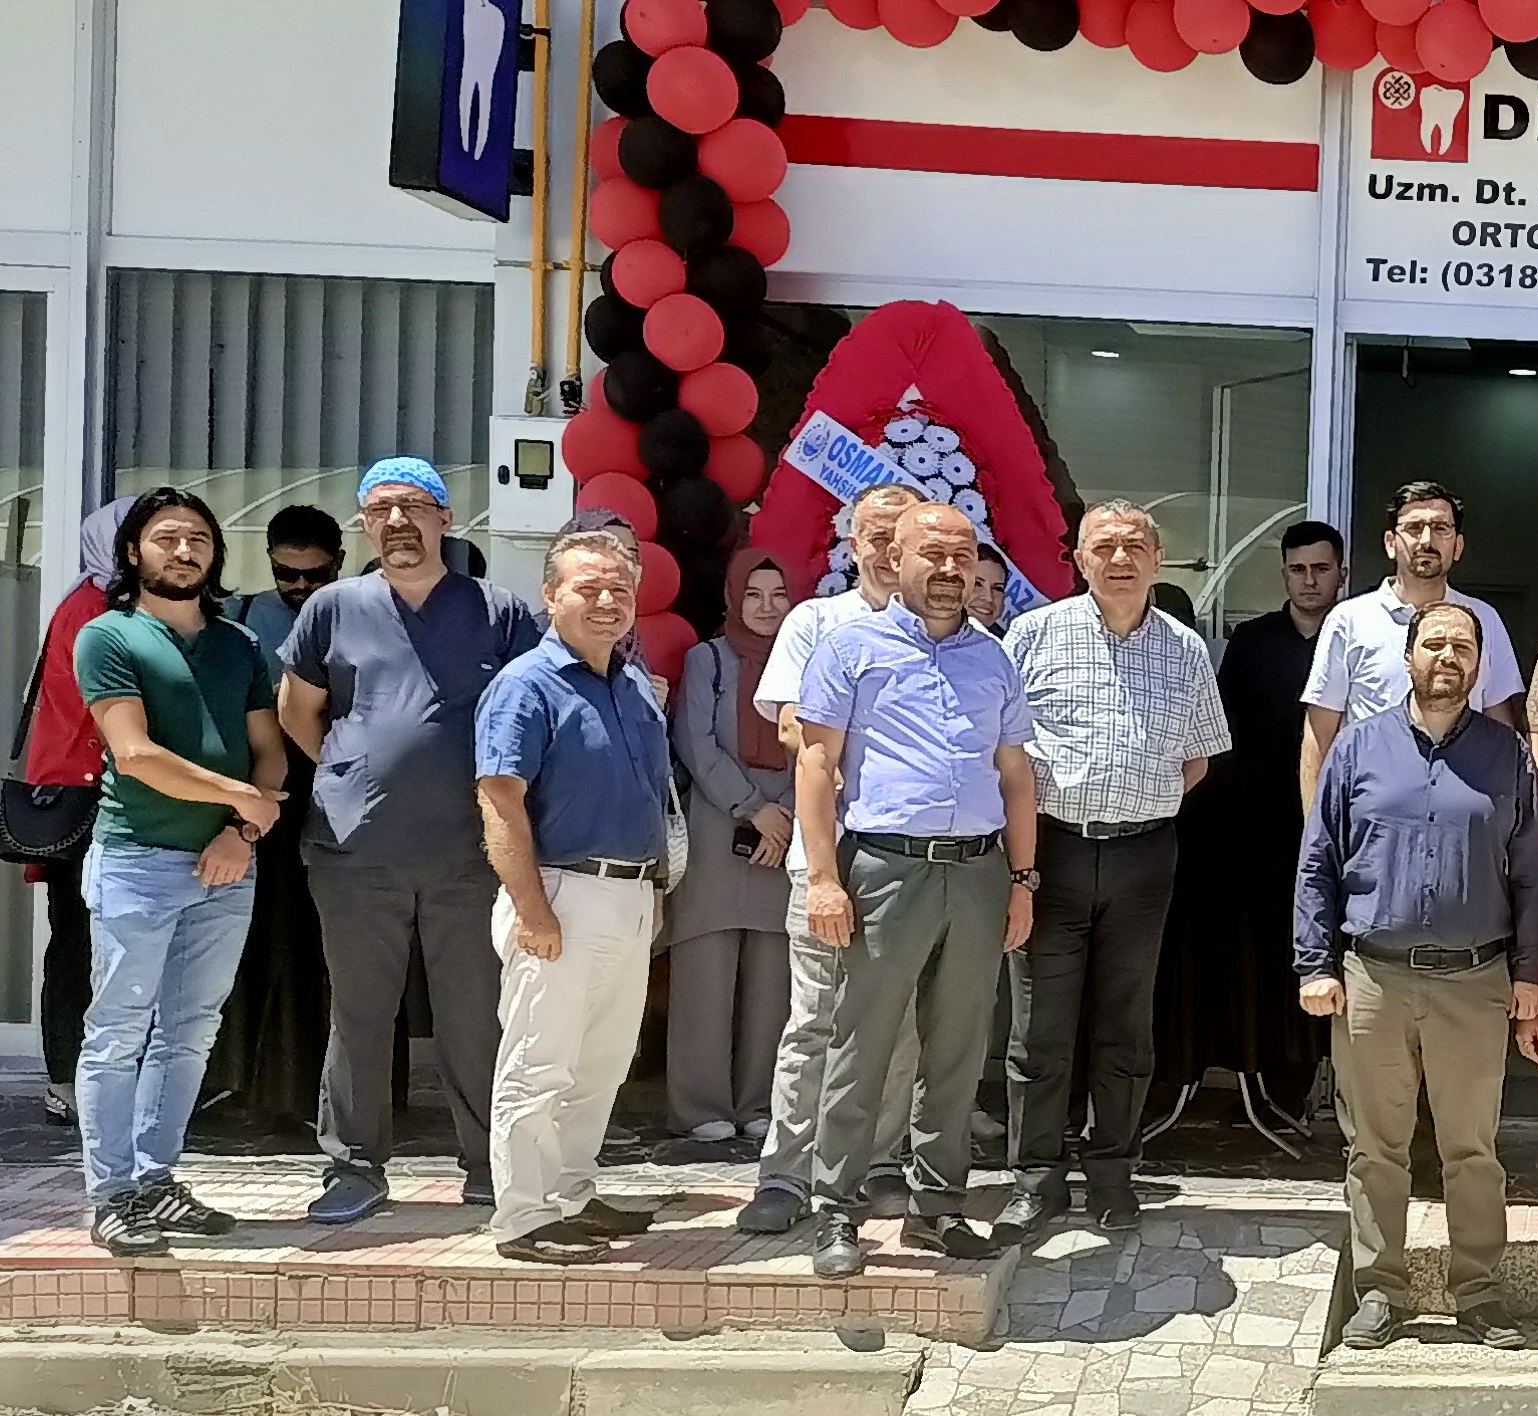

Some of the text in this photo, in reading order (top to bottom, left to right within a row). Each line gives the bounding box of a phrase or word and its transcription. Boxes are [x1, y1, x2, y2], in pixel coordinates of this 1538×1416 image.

[1368, 174, 1460, 203] Uzm.
[1476, 179, 1527, 206] Dt.
[1366, 257, 1428, 284] Tel:
